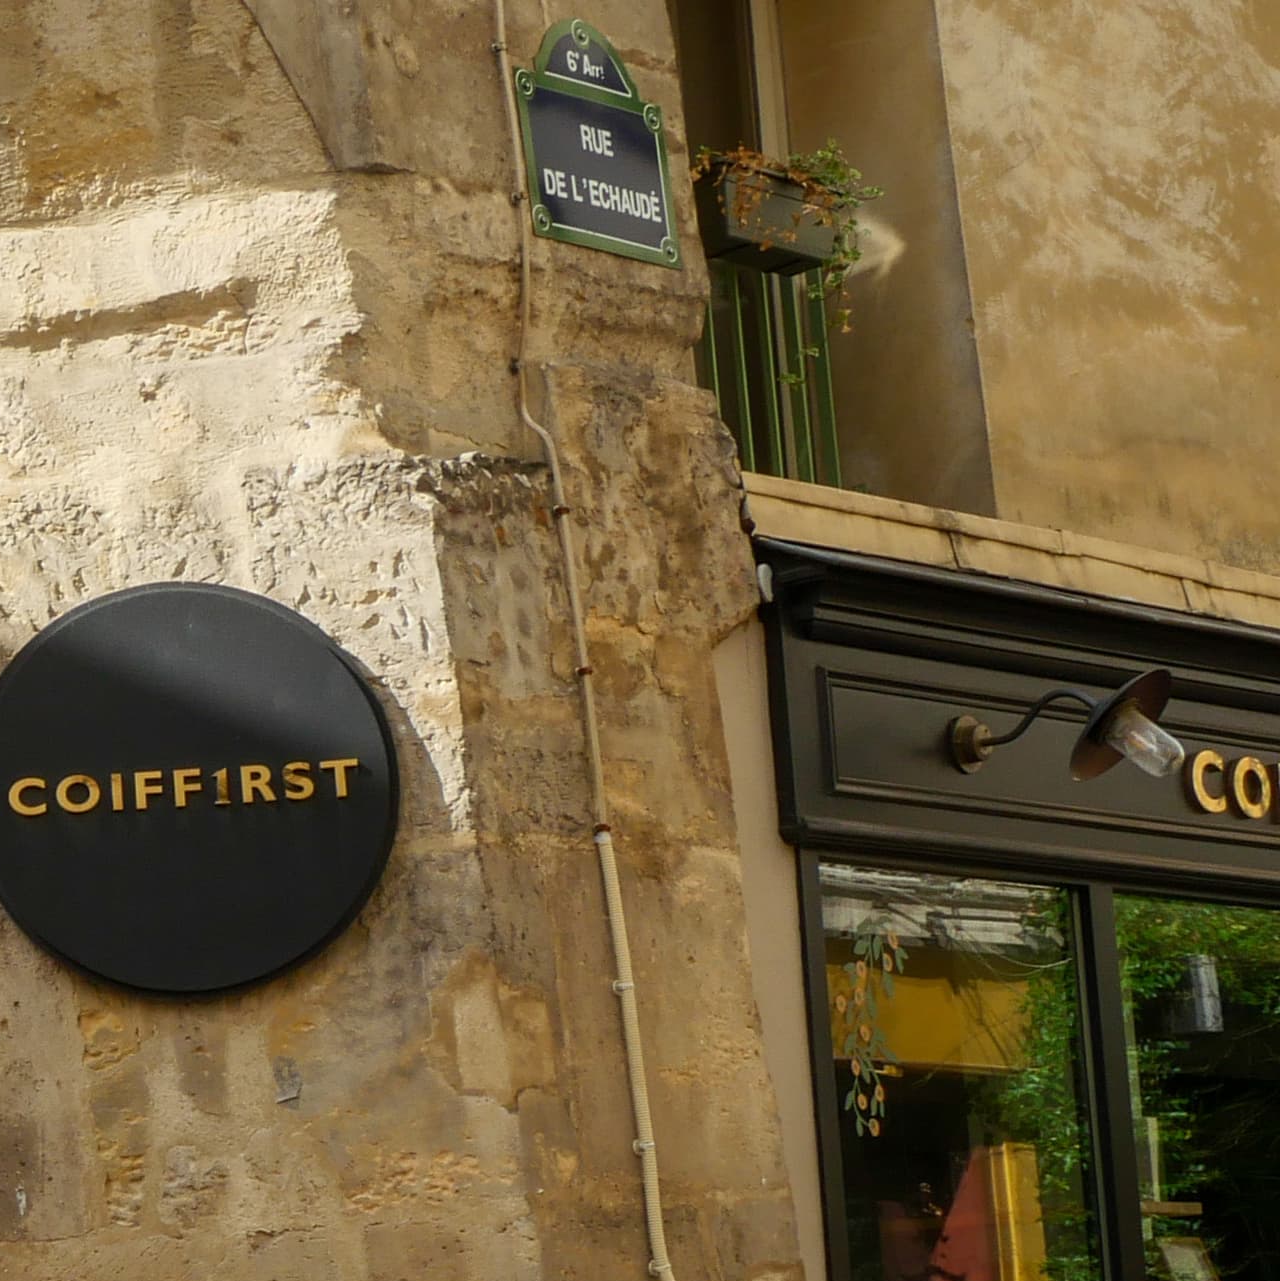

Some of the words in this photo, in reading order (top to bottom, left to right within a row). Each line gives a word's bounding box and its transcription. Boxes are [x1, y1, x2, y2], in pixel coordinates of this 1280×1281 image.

[580, 124, 614, 158] RUE
[543, 168, 568, 200] DE
[571, 174, 663, 223] L'ECHAUDÉ
[1192, 750, 1280, 822] CO
